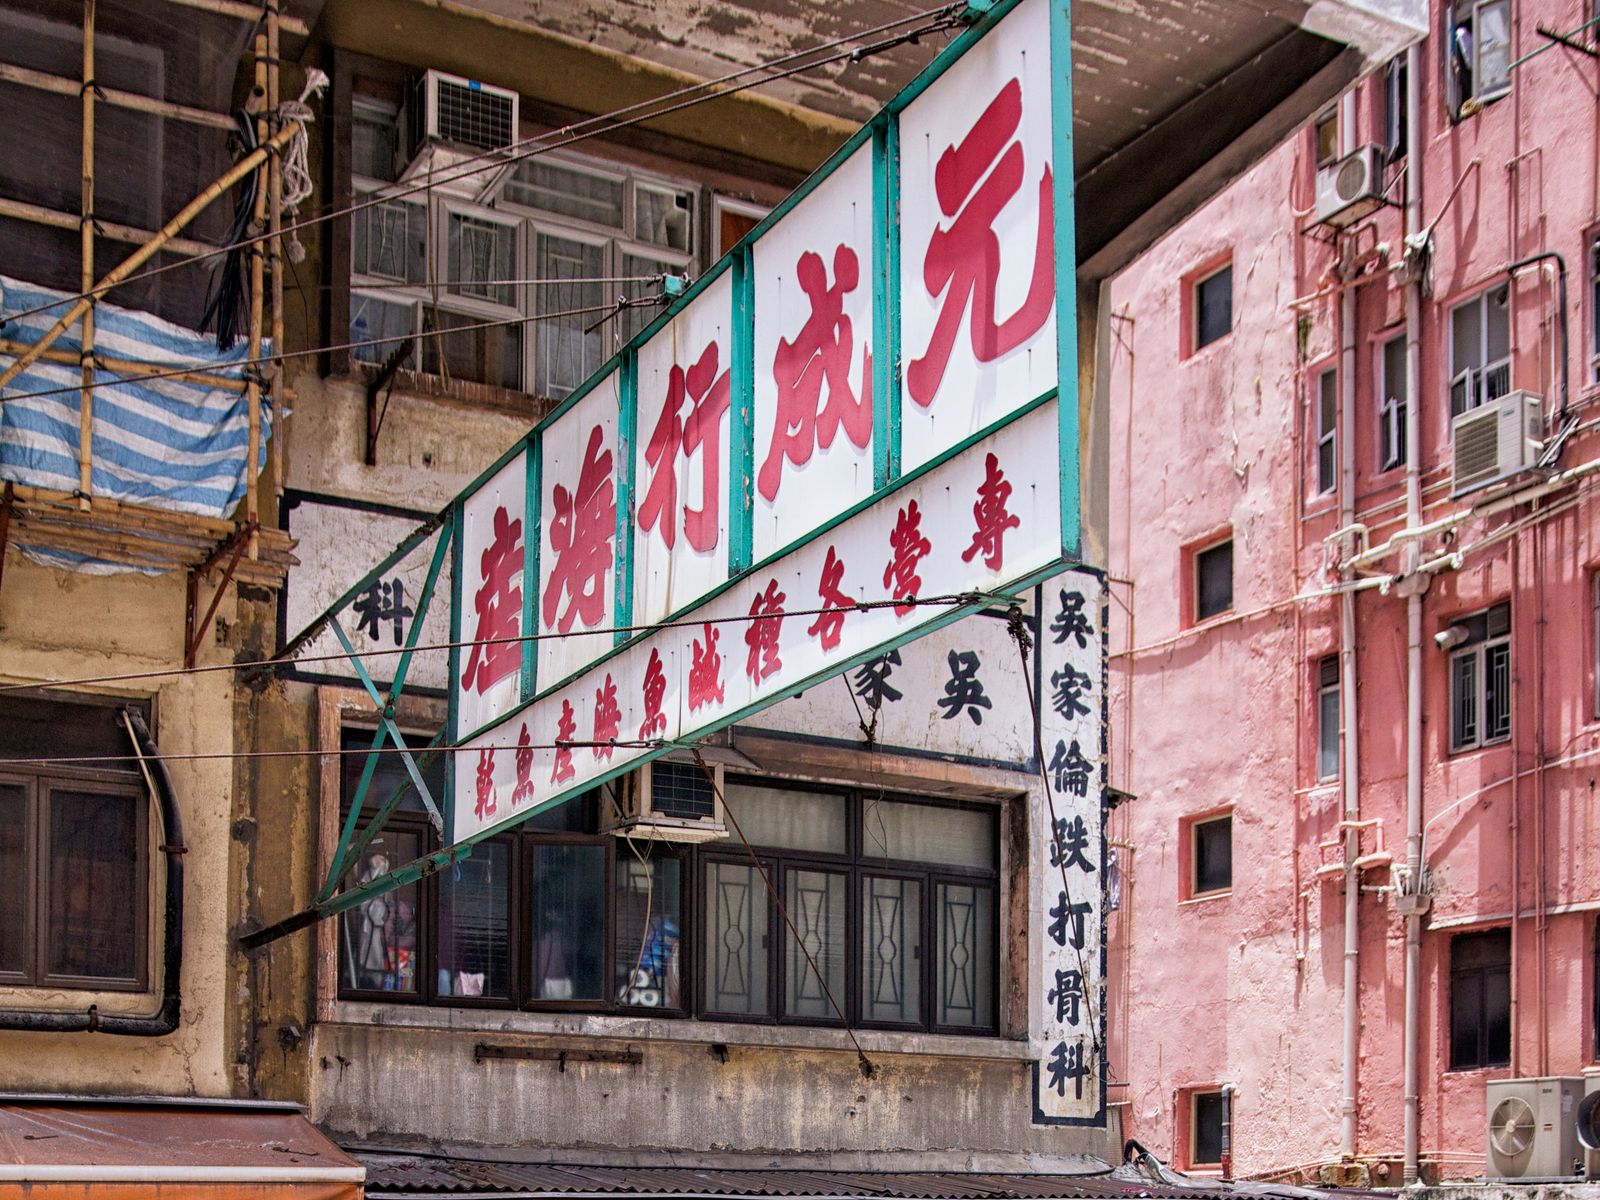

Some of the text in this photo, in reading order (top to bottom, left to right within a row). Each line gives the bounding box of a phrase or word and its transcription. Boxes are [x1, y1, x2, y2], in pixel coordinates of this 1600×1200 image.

[1047, 588, 1096, 1100] 吳家倫跌打骨科
